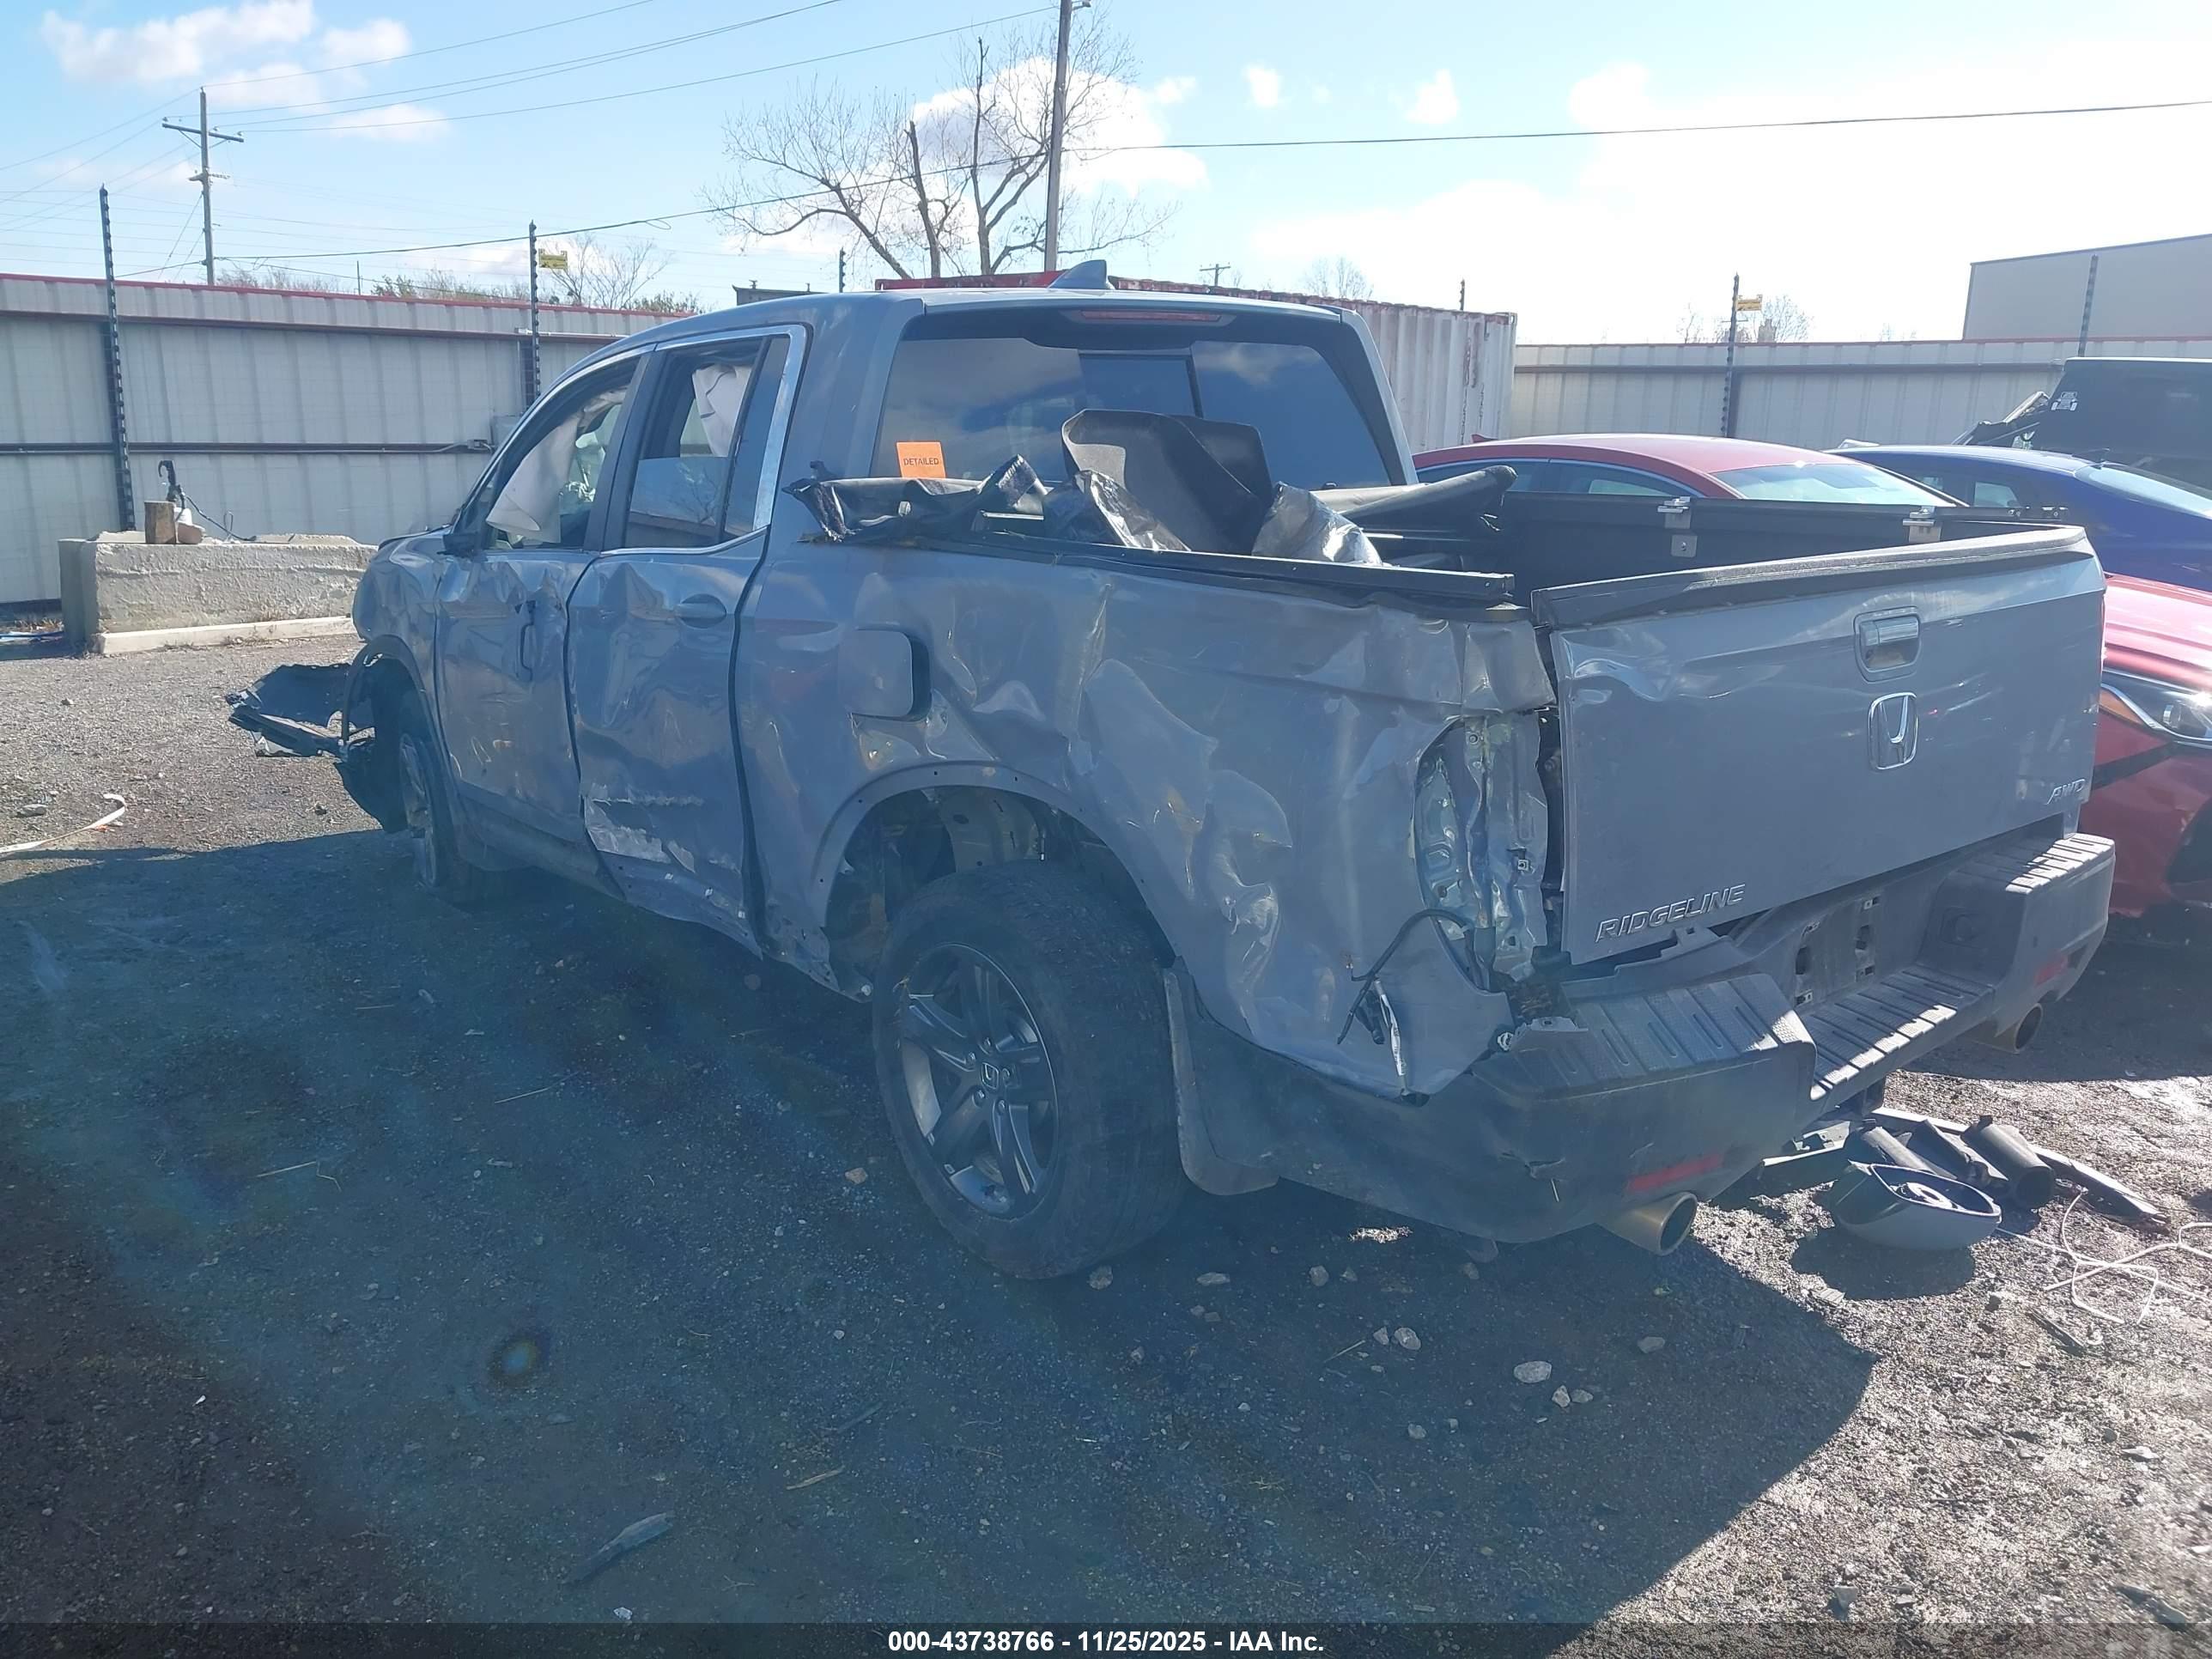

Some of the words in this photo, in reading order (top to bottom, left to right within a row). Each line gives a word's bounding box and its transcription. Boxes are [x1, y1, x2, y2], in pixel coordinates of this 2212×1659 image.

[903, 458, 939, 466] DETAILED
[2047, 778, 2086, 805] AWD
[1595, 884, 1746, 943] RIDGELINE
